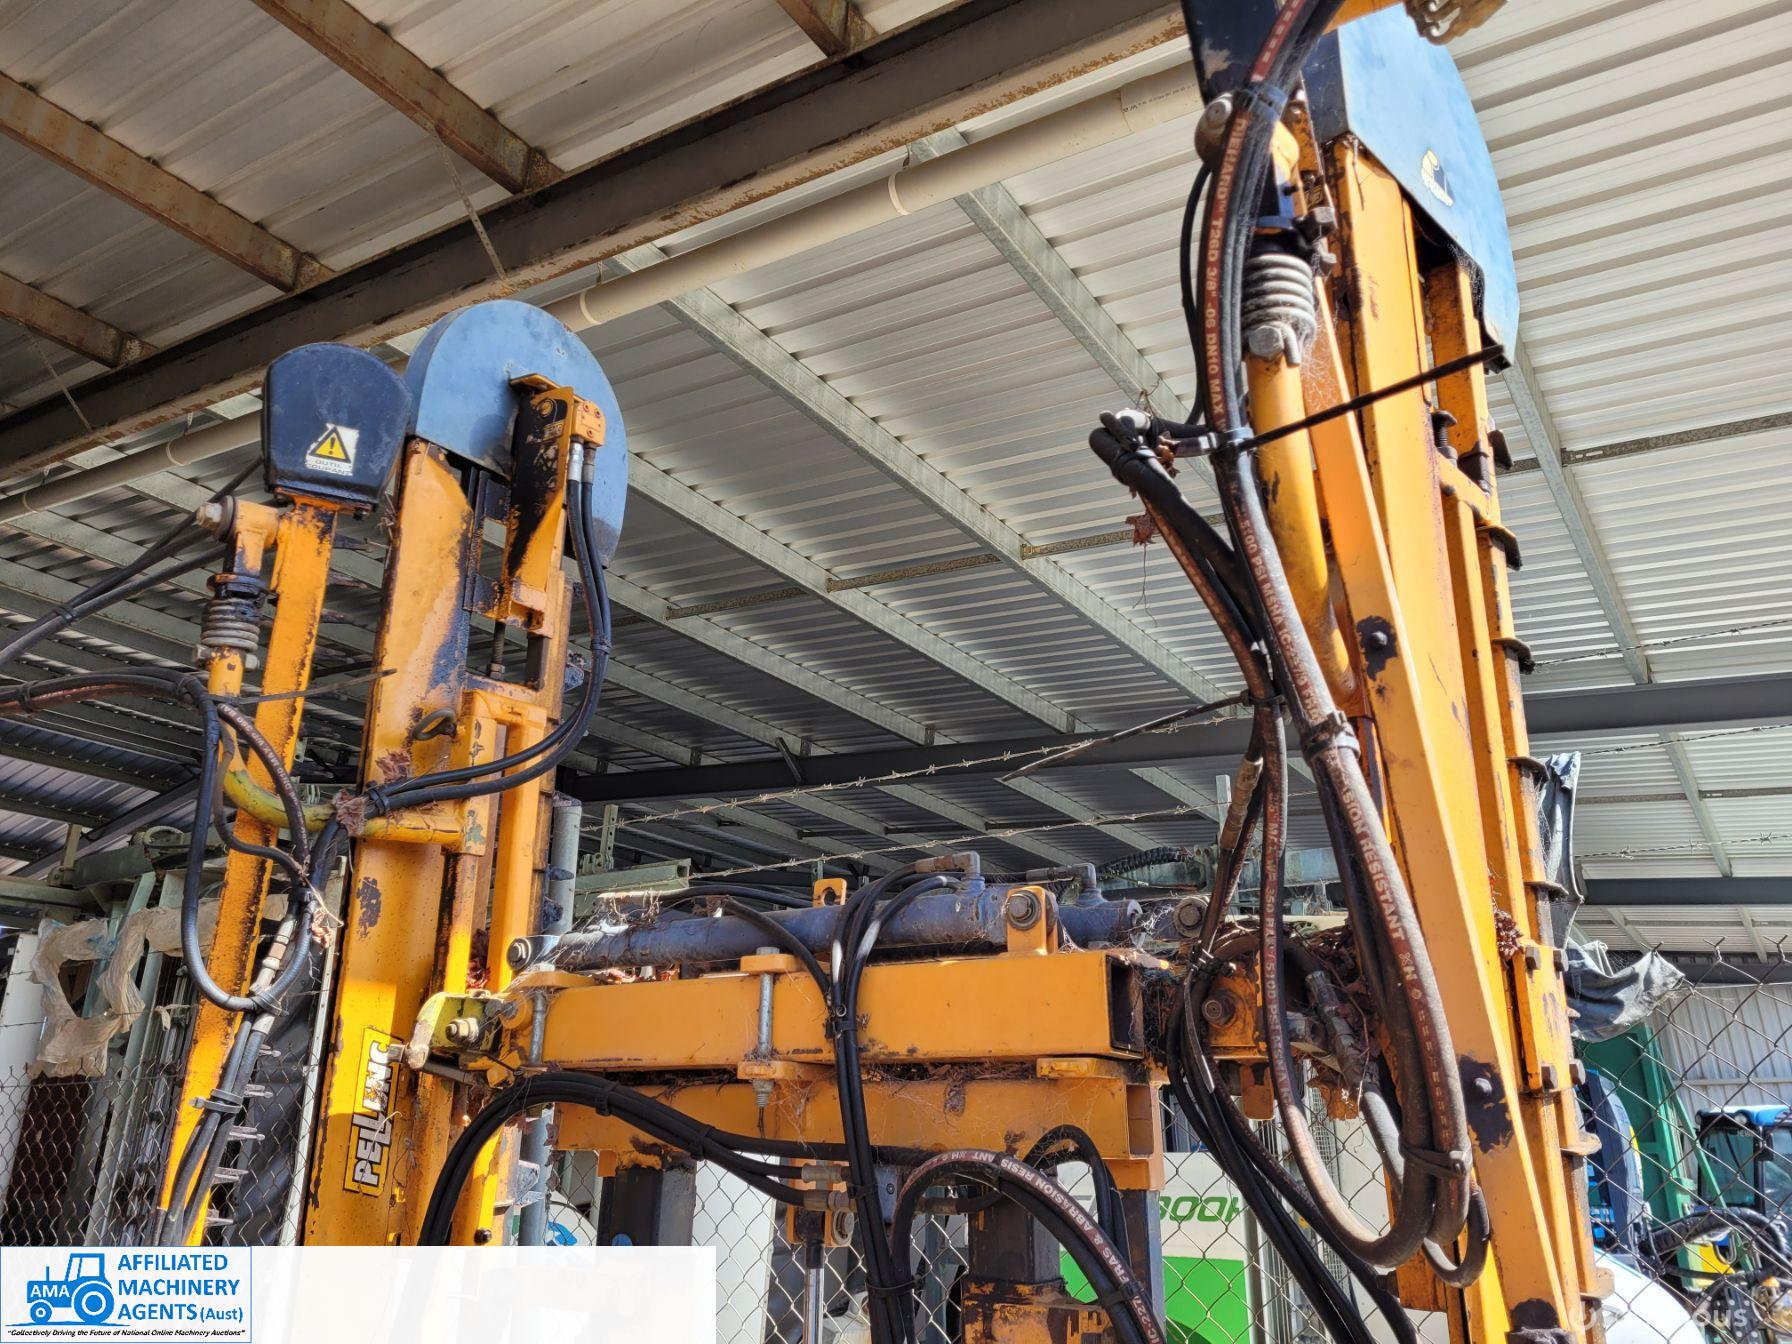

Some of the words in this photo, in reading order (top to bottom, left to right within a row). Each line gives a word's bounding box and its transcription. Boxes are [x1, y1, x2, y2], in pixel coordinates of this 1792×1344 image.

[1205, 216, 1224, 262] T26D
[1204, 332, 1219, 375] DN10
[1207, 377, 1225, 414] MAX
[1249, 554, 1269, 581] PSI
[1258, 581, 1286, 626] MSHA
[1266, 887, 1274, 912] 350
[1356, 835, 1406, 944] RESISTANT
[971, 1150, 1037, 1182] RESISANT
[1033, 1173, 1093, 1235] ABRASION
[1090, 1232, 1104, 1246] &
[1099, 1244, 1130, 1285] FRAS
